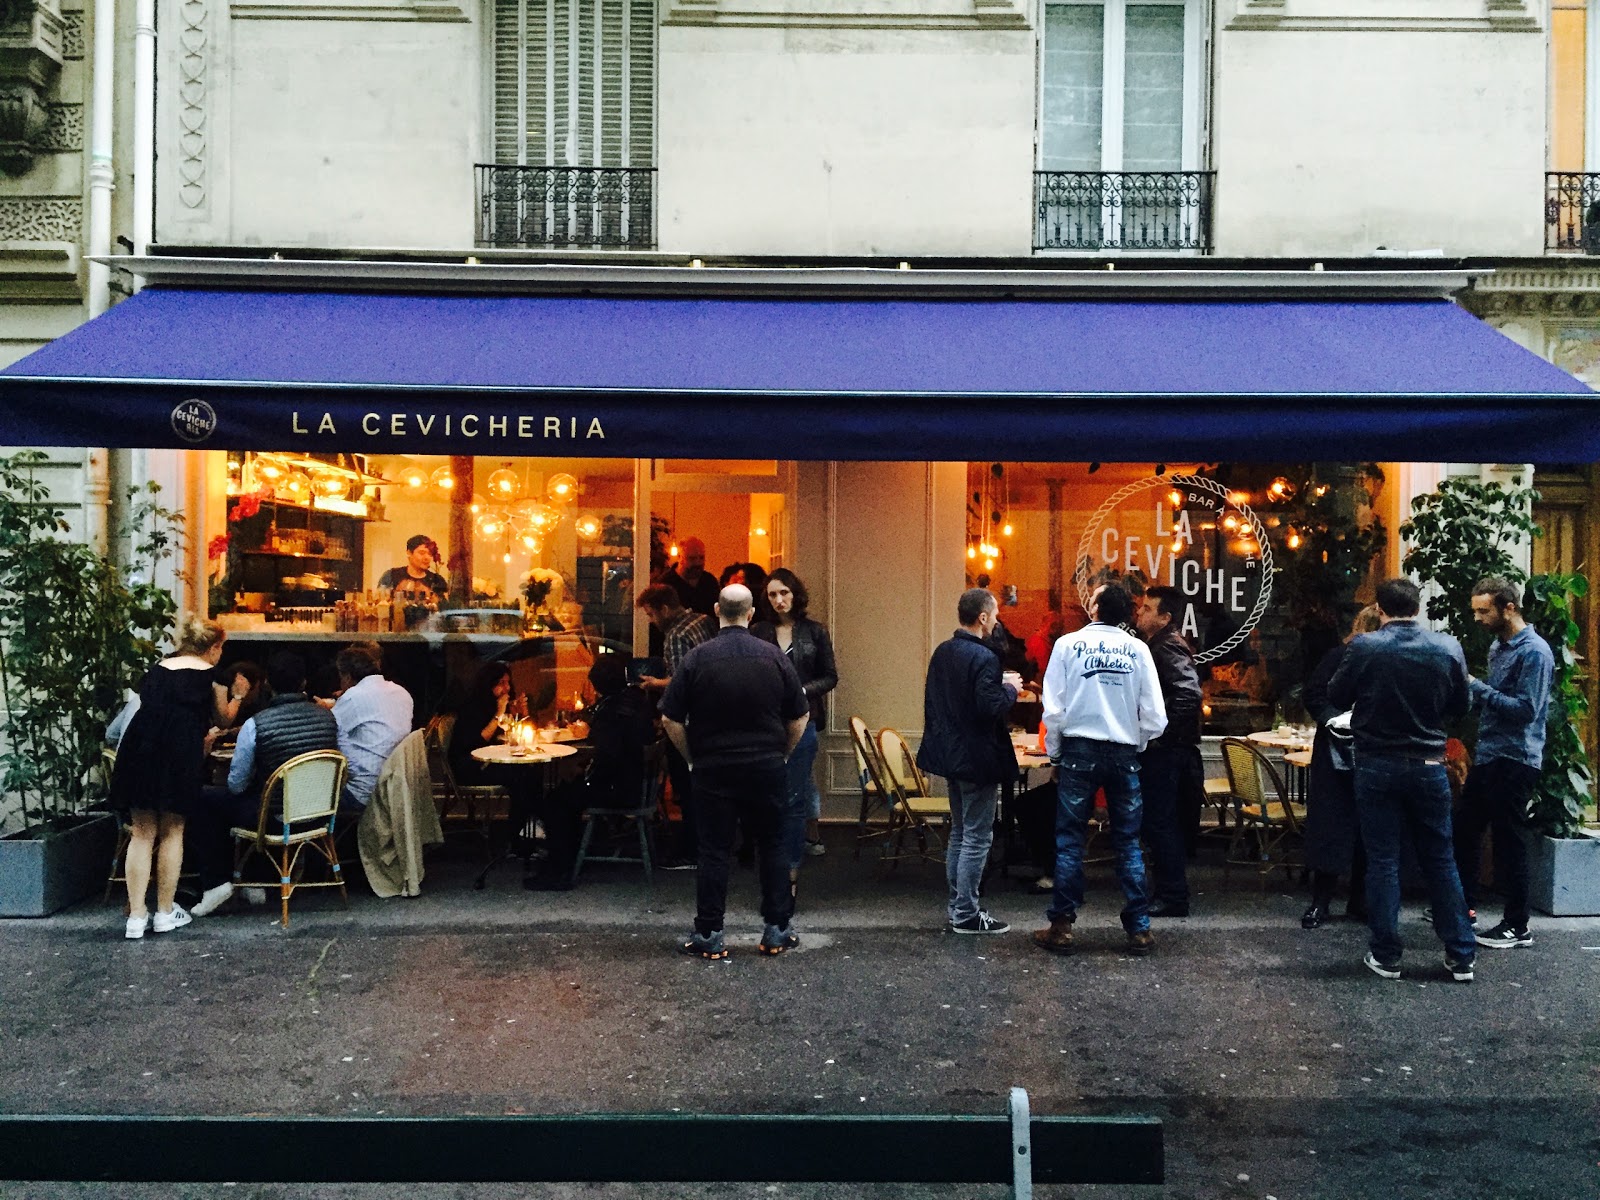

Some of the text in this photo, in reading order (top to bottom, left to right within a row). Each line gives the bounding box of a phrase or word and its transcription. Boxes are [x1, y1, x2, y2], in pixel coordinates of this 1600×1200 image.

[176, 409, 211, 430] CEVICHE
[189, 404, 199, 415] LA
[292, 411, 605, 439] LA CEVICHERIA
[1188, 492, 1215, 509] BAR
[1156, 501, 1194, 545] LA
[1101, 527, 1247, 612] CEVICHE
[1072, 640, 1137, 660] Parksville
[1084, 655, 1134, 671] Athletics
